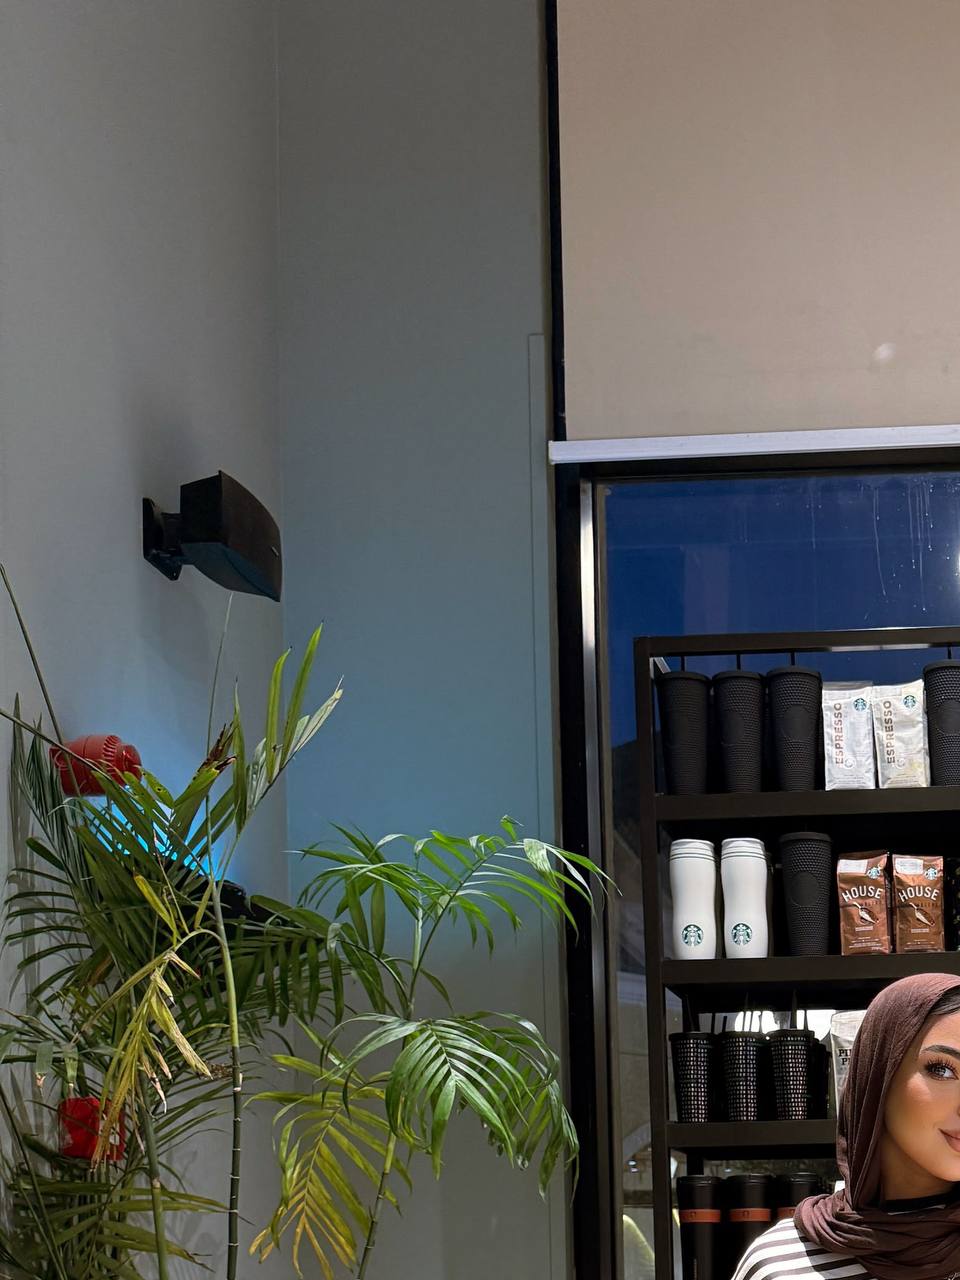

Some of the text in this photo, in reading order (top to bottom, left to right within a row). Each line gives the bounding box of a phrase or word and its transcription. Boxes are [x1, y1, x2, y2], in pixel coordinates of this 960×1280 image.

[834, 703, 844, 764] ESPRESSO
[883, 701, 895, 764] ESPRESSO
[842, 886, 883, 902] HOUSE
[899, 886, 939, 902] HOUSE
